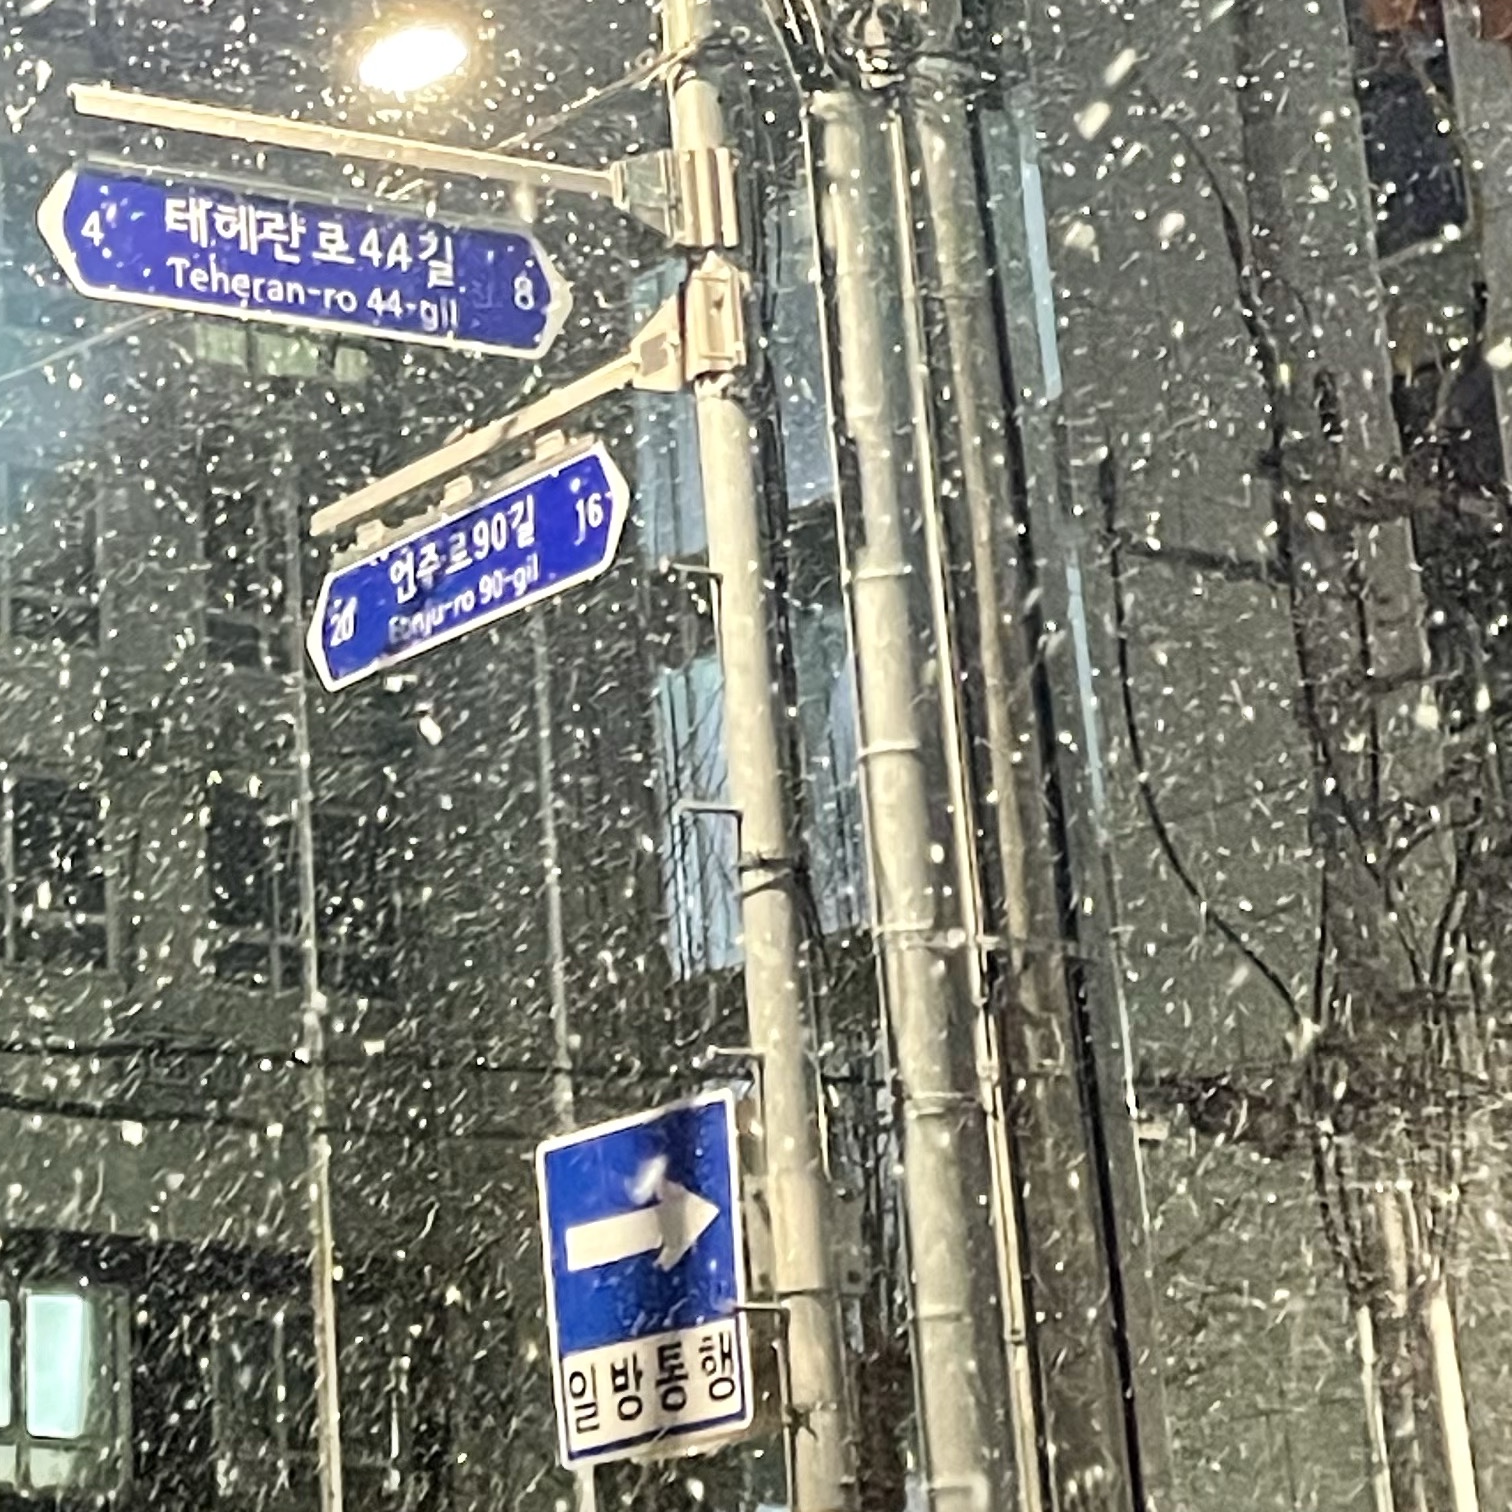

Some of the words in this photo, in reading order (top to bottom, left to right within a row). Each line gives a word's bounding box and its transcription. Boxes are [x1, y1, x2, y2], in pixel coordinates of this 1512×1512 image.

[81, 209, 103, 246] 4
[165, 197, 455, 289] 테헤란로44길
[166, 254, 357, 313] Teheran-ro
[366, 287, 460, 334] 44-gil
[513, 275, 534, 312] 8
[478, 553, 538, 604] 90-gil
[330, 600, 357, 646] 20
[569, 1329, 736, 1434] 일방통행
